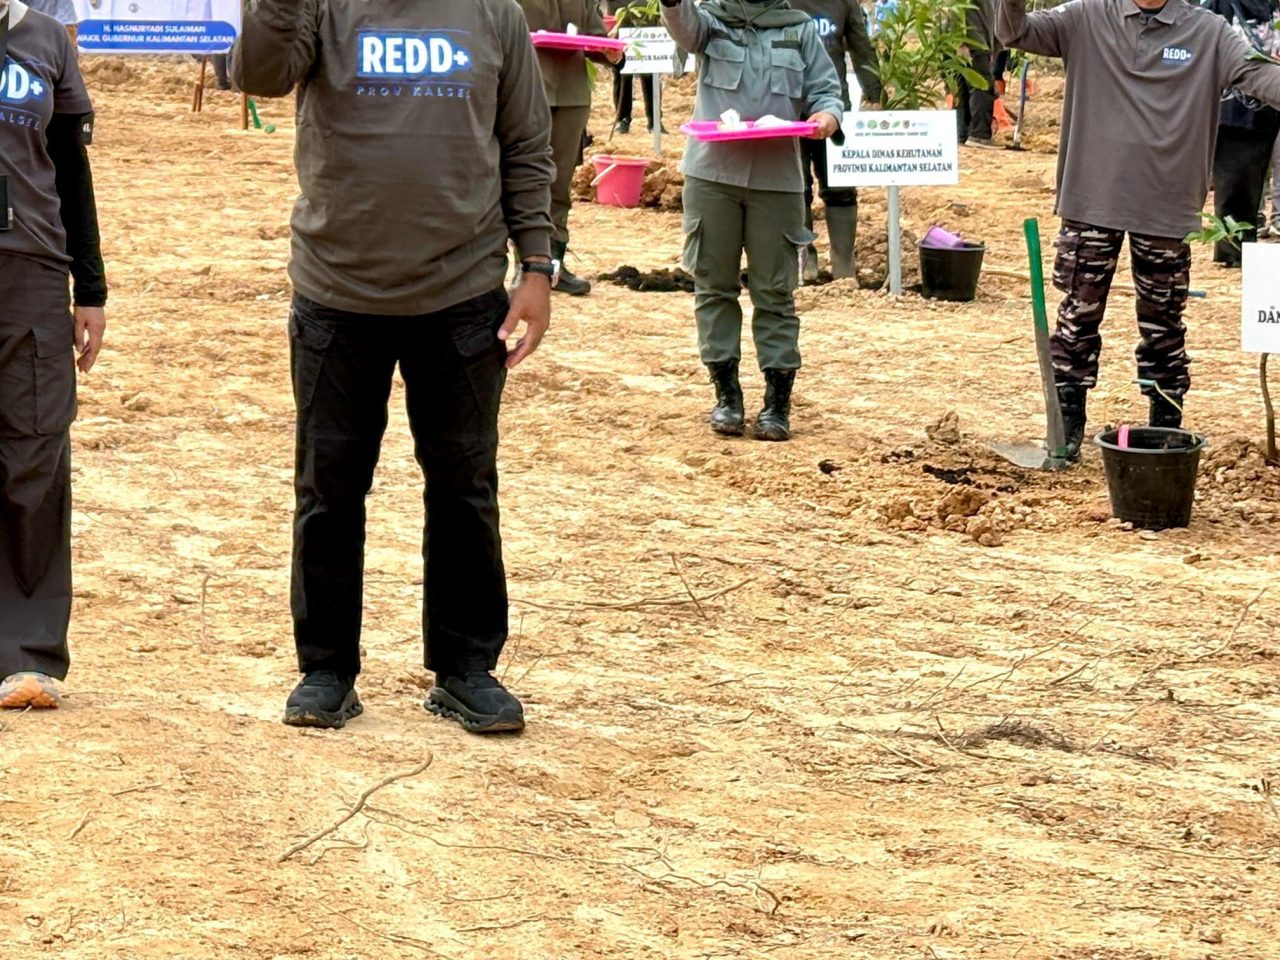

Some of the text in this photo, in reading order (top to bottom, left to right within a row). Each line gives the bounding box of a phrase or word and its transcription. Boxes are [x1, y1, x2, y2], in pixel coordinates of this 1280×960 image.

[164, 25, 206, 33] SULAIMAN
[102, 34, 145, 42] GUBERNUR
[146, 35, 198, 43] KALIMANTAN
[362, 36, 468, 73] REDD+
[1163, 47, 1191, 60] REDD+
[356, 86, 402, 96] PROV
[842, 148, 942, 159] KEPALA DINAS KEHUTANAN
[833, 162, 952, 173] PROVINSI KALIMANTAN SELATAN
